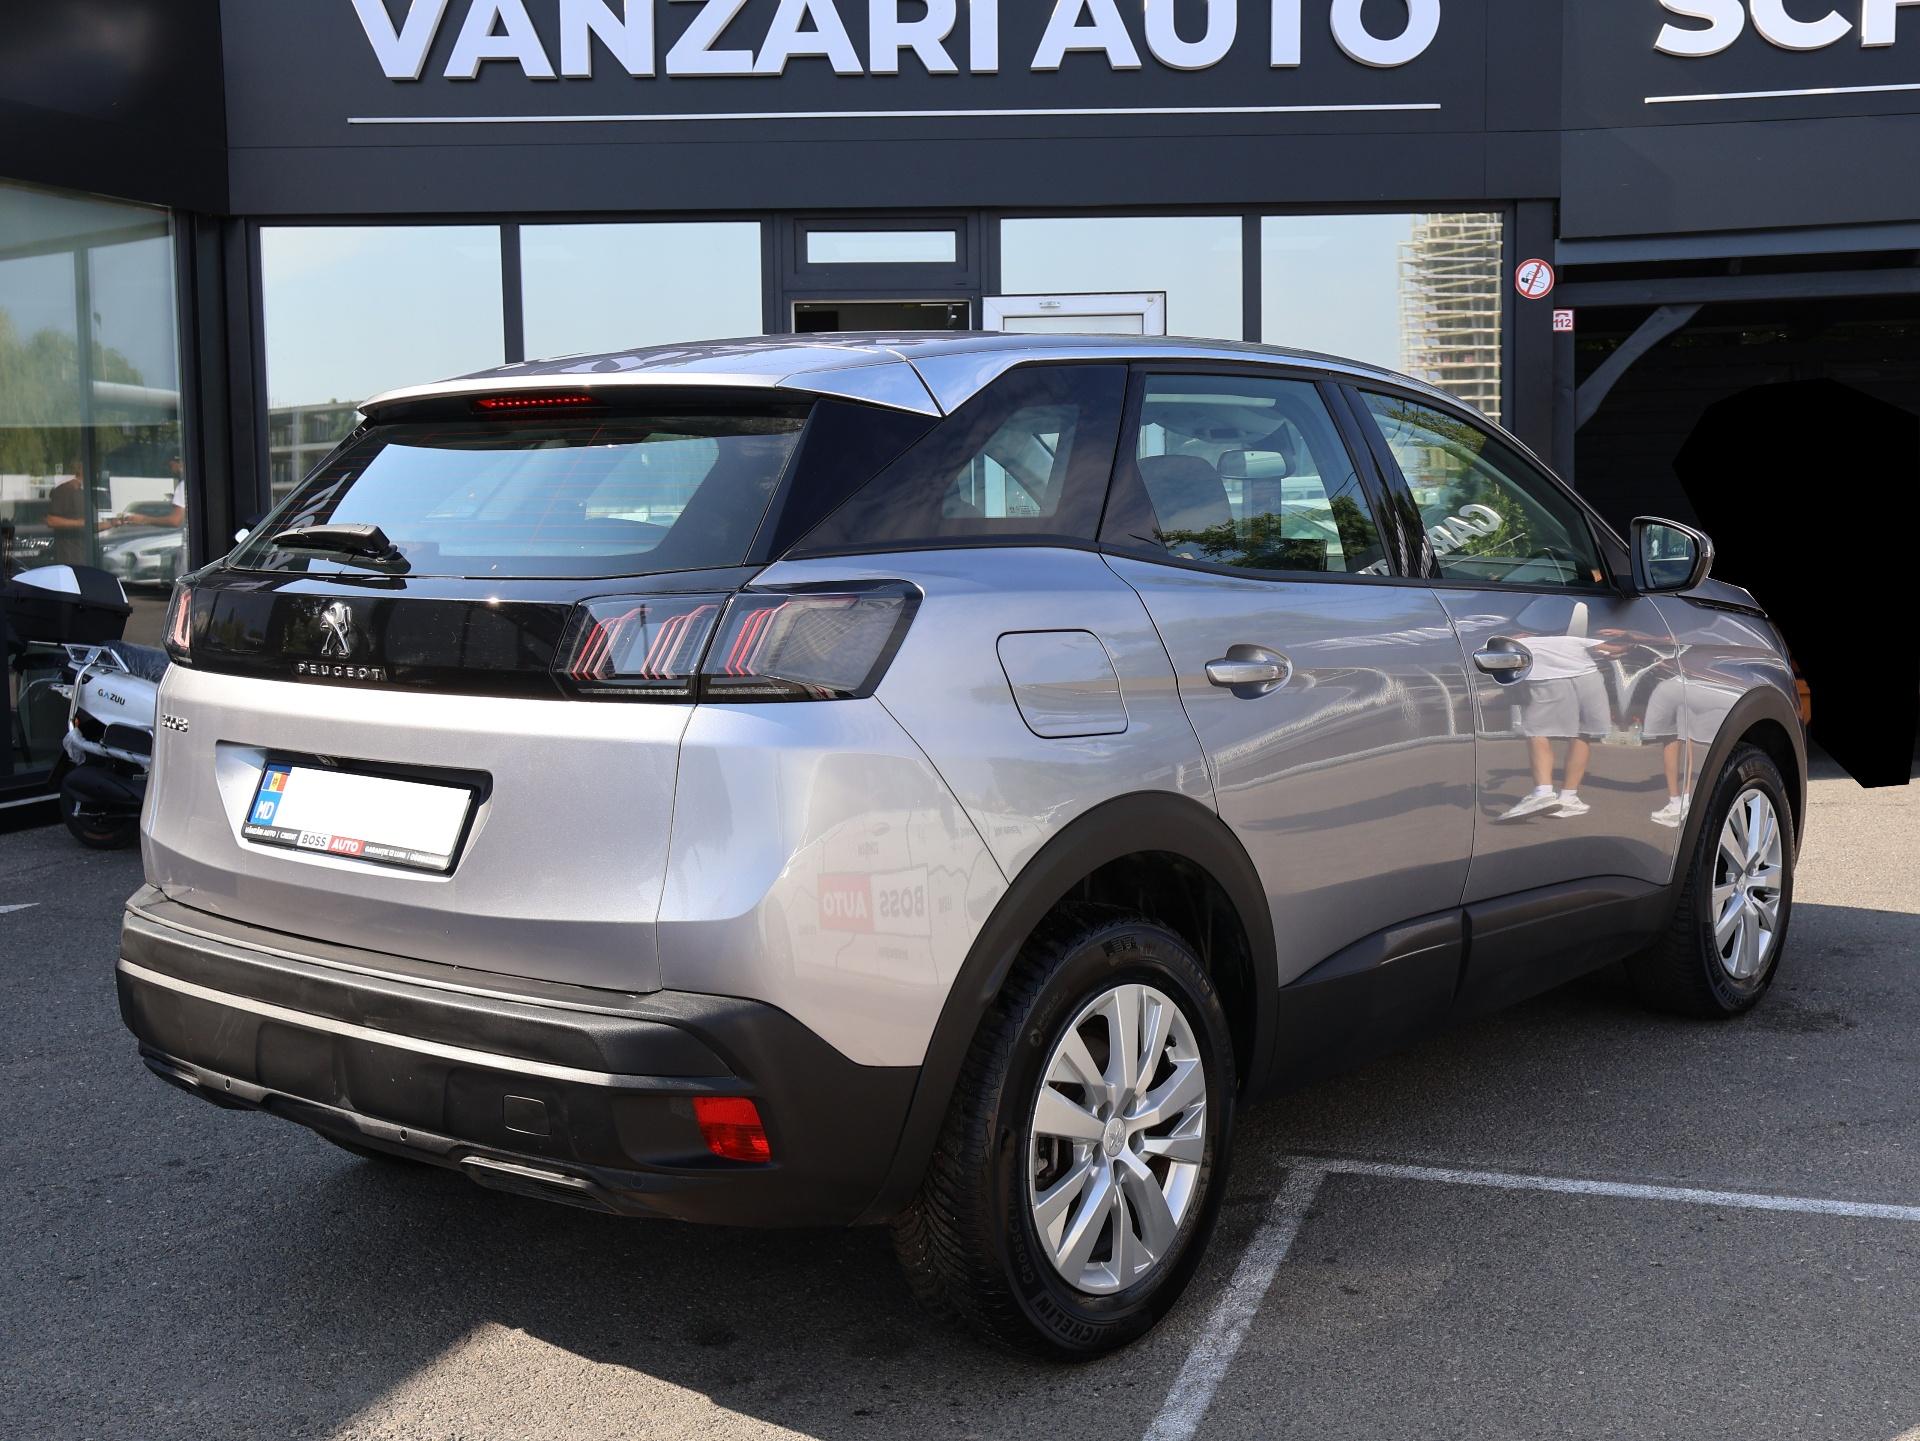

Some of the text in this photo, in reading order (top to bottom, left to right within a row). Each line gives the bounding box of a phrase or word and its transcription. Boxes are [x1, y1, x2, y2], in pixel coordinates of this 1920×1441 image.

[1030, 0, 1441, 71] AUTO
[1553, 318, 1572, 328] 112
[298, 663, 385, 681] PEUGEOT
[97, 688, 126, 706] GAZUU
[255, 801, 275, 820] MD
[301, 834, 360, 854] BOSS AUTO
